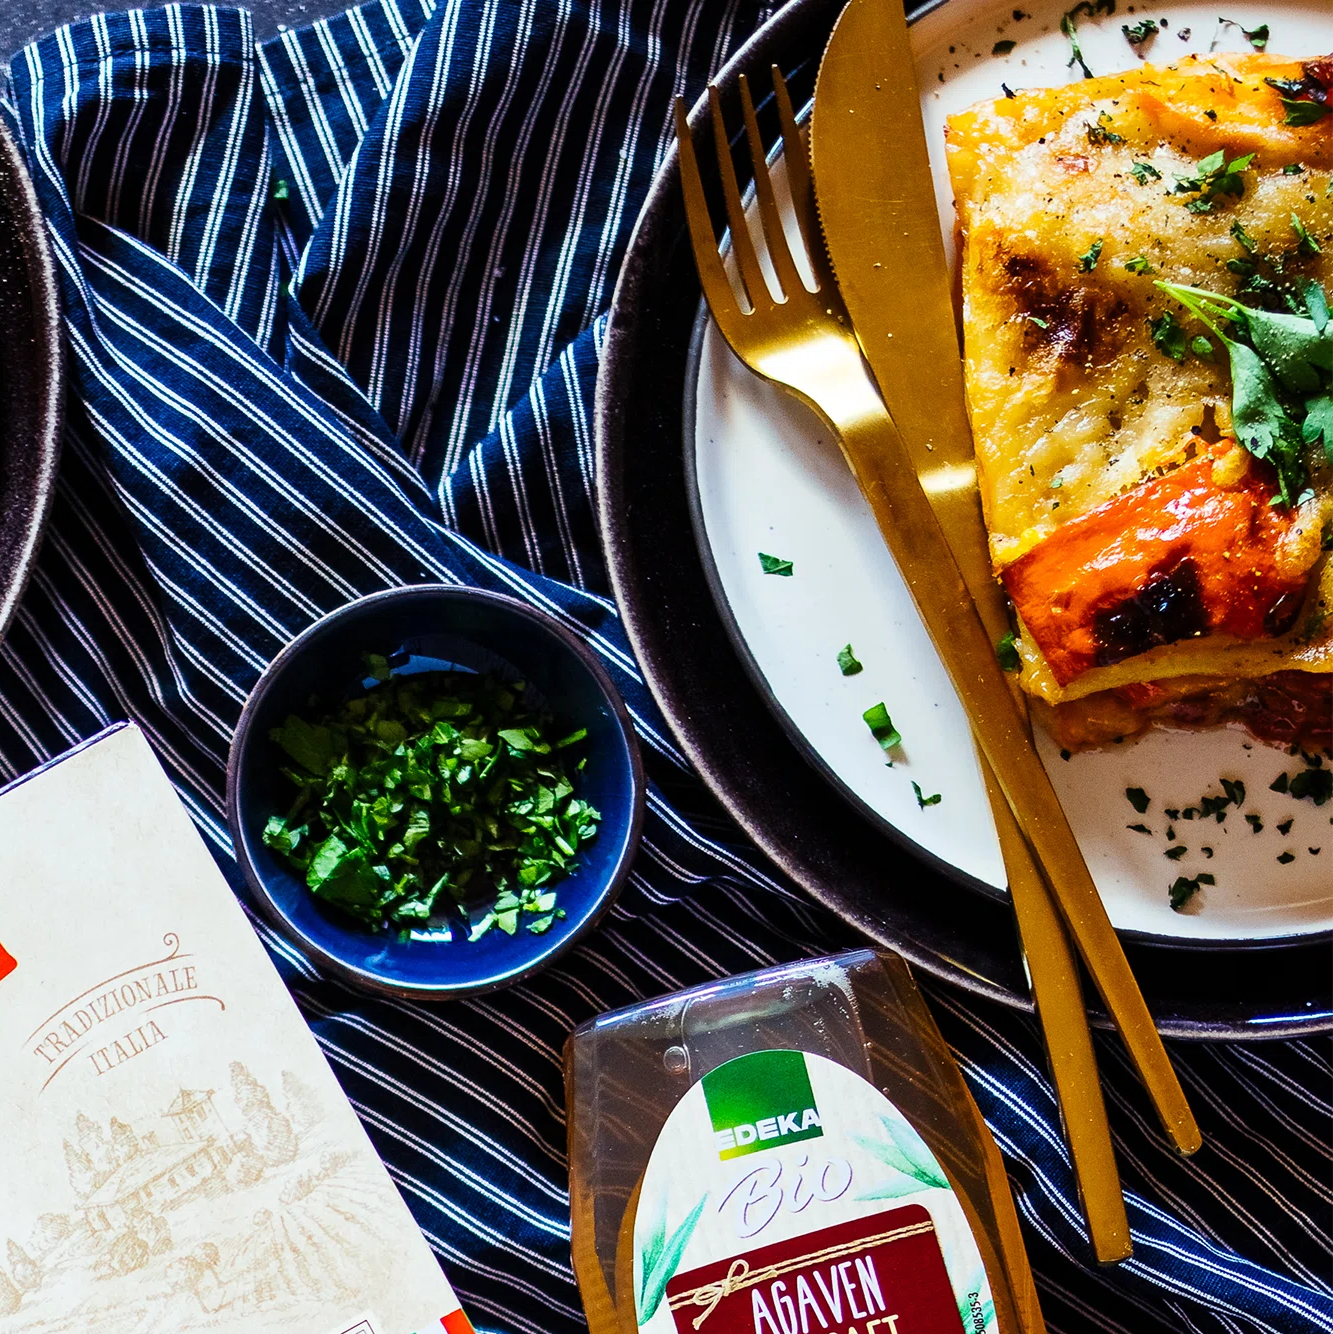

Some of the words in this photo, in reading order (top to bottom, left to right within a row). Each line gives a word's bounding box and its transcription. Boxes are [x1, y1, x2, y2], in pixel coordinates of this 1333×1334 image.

[33, 965, 198, 1064] TRADIZIONALE
[87, 1020, 169, 1076] ITALIA
[713, 1108, 823, 1150] EDEKA
[718, 1155, 853, 1238] Bio
[968, 1291, 987, 1334] 508535-3
